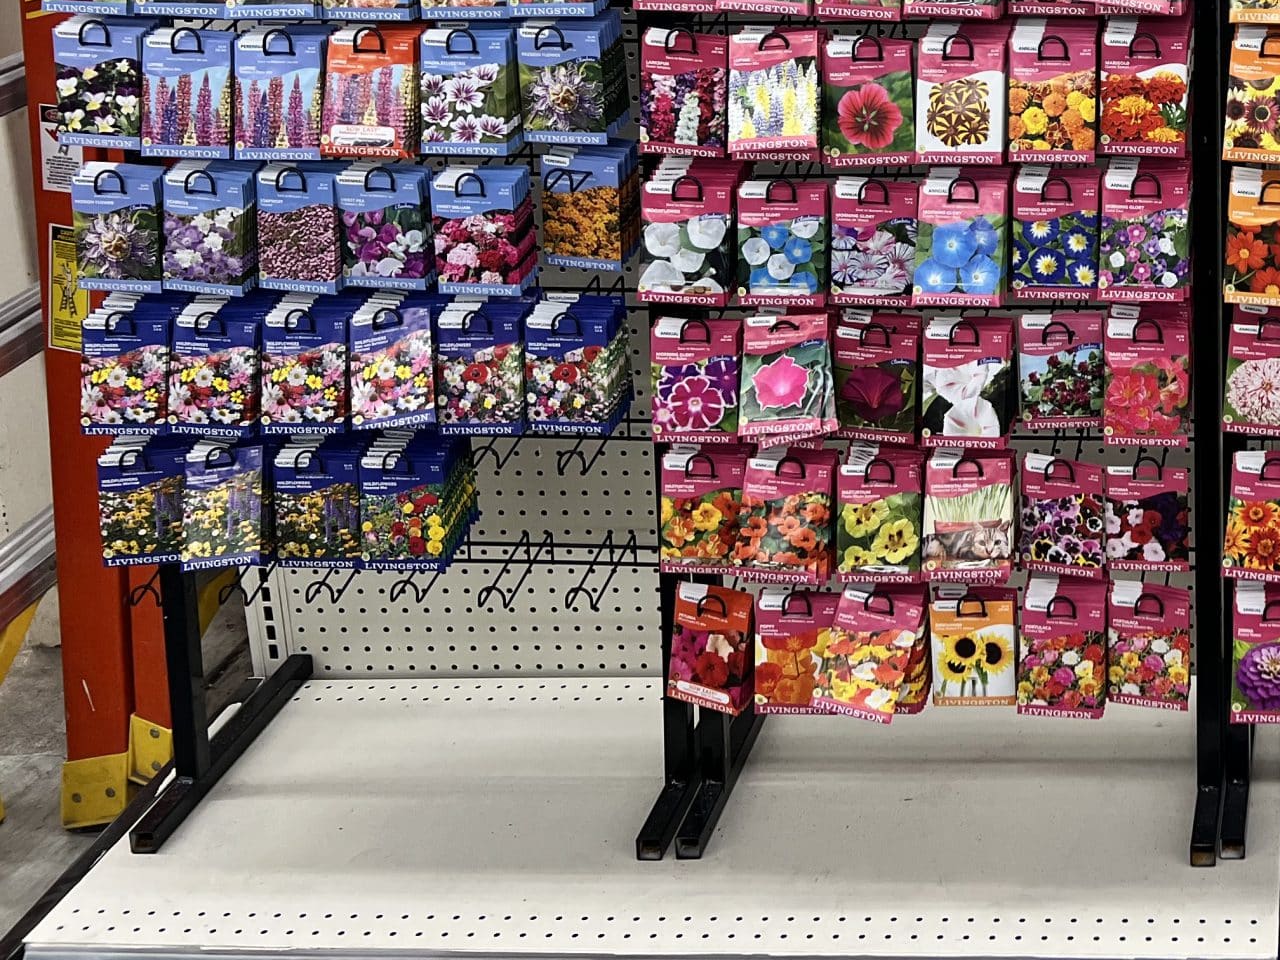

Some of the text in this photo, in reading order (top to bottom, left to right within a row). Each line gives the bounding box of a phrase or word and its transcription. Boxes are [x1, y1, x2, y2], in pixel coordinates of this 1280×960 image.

[140, 6, 217, 16] LIVINGSTON
[720, 2, 798, 14] LIVINGSTON
[907, 6, 982, 16] LIVINGSTON
[1013, 6, 1087, 15] LIVINGSTON
[328, 10, 400, 20] LIVINGSTON
[424, 9, 500, 19] LIVINGSTON
[528, 133, 600, 144] LIVINGSTON
[732, 140, 808, 150] LIVINGSTON
[1104, 145, 1176, 154] LIVINGSTON
[145, 147, 220, 158] LIVINGSTON
[325, 147, 399, 157] LIVINGSTON
[920, 155, 993, 164] LIVINGSTON
[167, 282, 233, 295] LIVINGSTON
[441, 285, 512, 295] LIVINGSTON
[1103, 290, 1174, 300] LIVINGSTON
[741, 297, 814, 307] LIVINGSTON
[917, 297, 989, 307] LIVINGSTON
[172, 426, 242, 436] LIVINGSTON
[442, 427, 513, 436] LIVINGSTON
[531, 424, 602, 434] LIVINGSTON
[926, 439, 996, 449] LIVINGSTON
[1108, 437, 1180, 446] LIVINGSTON
[365, 562, 439, 571] LIVINGSTON
[1111, 563, 1181, 572] LIVINGSTON
